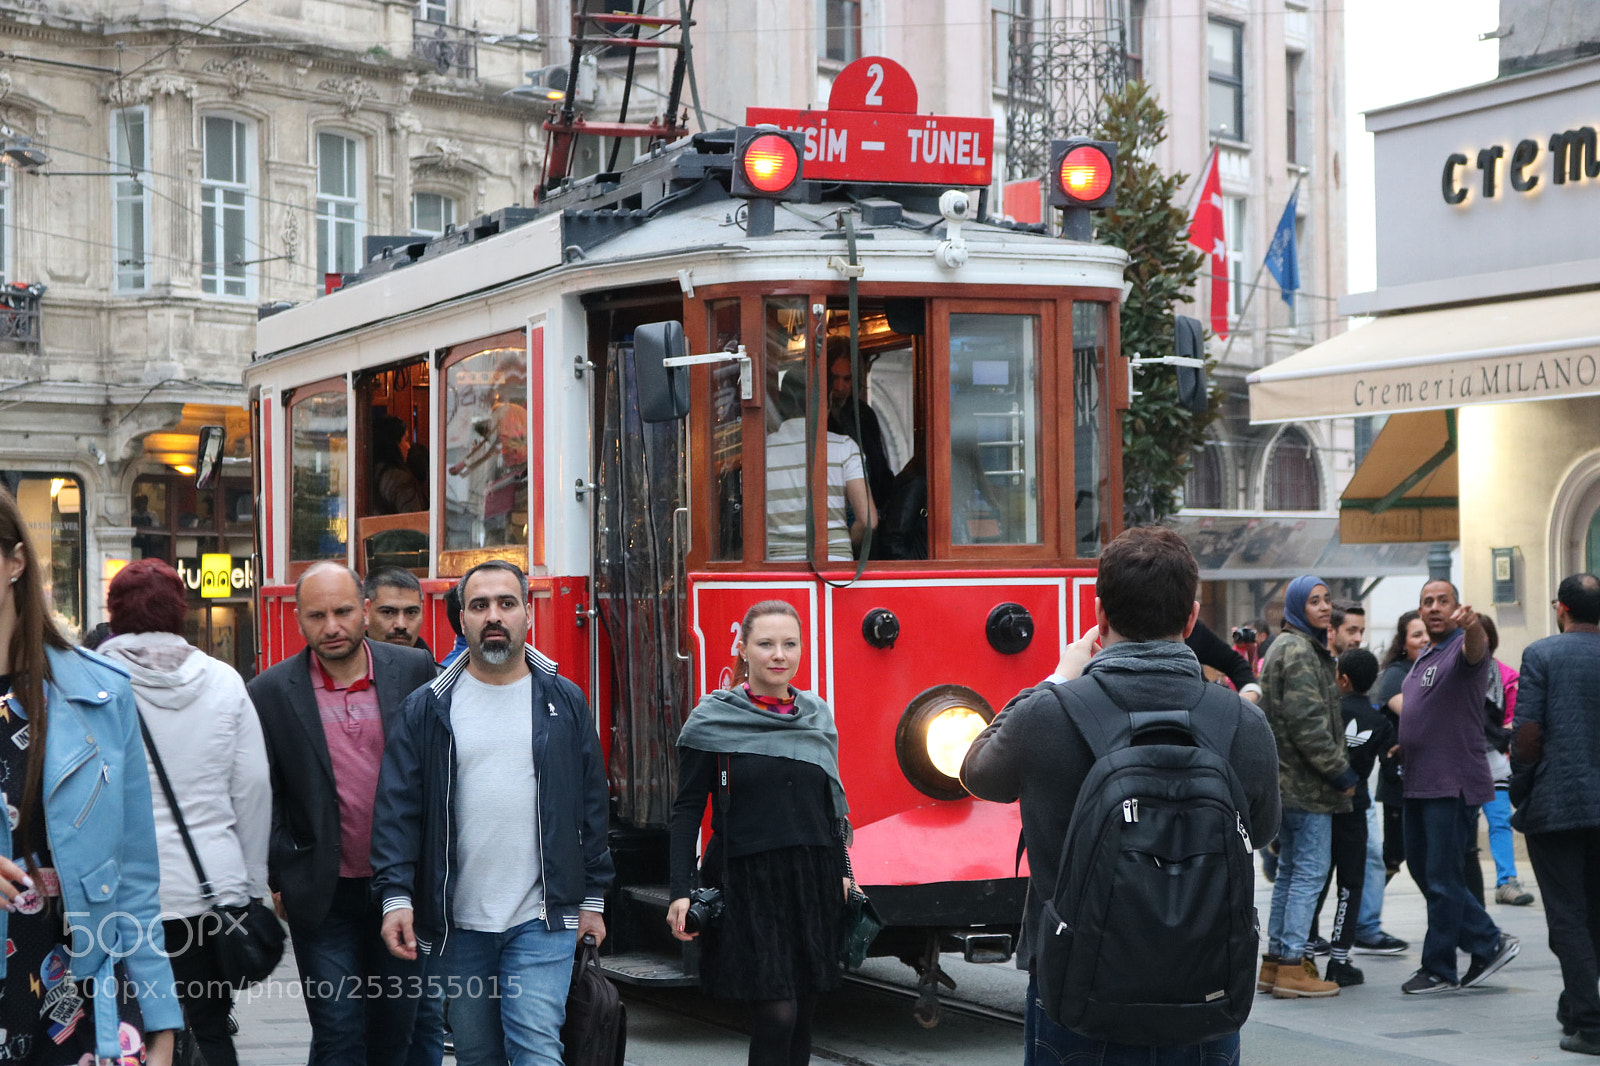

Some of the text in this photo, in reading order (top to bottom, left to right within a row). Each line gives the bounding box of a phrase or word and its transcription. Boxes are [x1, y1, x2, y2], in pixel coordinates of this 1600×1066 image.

[865, 63, 884, 106] 2
[907, 120, 985, 166] TÜNEL
[1354, 354, 1596, 406] Cremeria MILANO
